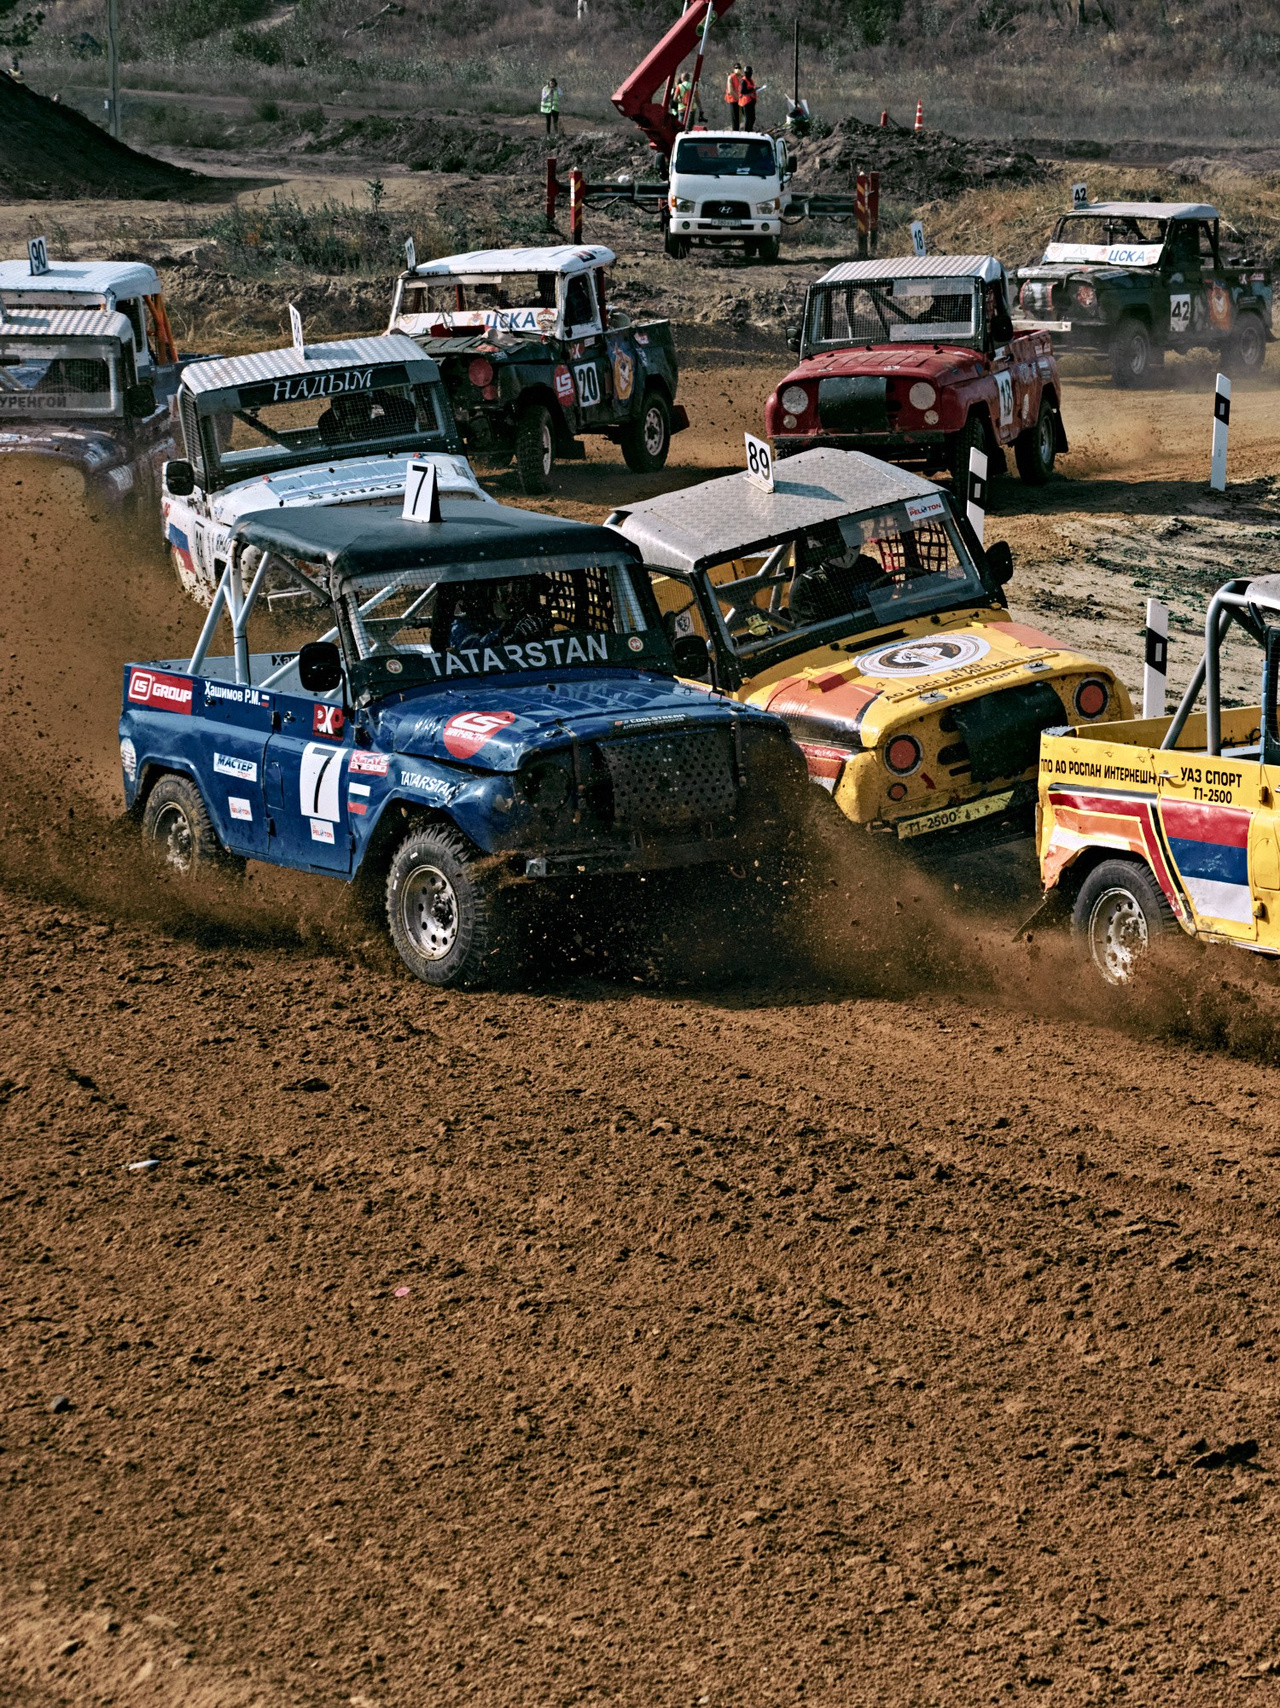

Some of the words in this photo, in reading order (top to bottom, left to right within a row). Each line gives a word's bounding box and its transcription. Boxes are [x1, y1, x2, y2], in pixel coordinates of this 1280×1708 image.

[1074, 187, 1087, 201] 42
[914, 229, 923, 250] 18
[31, 239, 46, 272] 90
[1108, 250, 1145, 262] ЦСКА
[485, 311, 536, 329] ЦСКА
[1172, 301, 1190, 321] 42
[273, 369, 374, 401] НАДЫМ
[578, 367, 599, 402] 20
[748, 441, 770, 480] 89
[412, 464, 428, 515] 7
[422, 634, 609, 677] TATARSTAN
[204, 680, 243, 702] Хашимов
[944, 683, 973, 693] УАЗ
[974, 668, 1020, 685] СПОРТ
[152, 682, 192, 703] GROUP
[885, 692, 904, 701] АО
[217, 755, 254, 772] МАСТЕР
[1055, 760, 1067, 774] АО
[1069, 761, 1102, 779] РОСПАН
[312, 746, 338, 814] 7
[1180, 766, 1200, 783] УАЗ
[1205, 770, 1243, 788] СПОРТ
